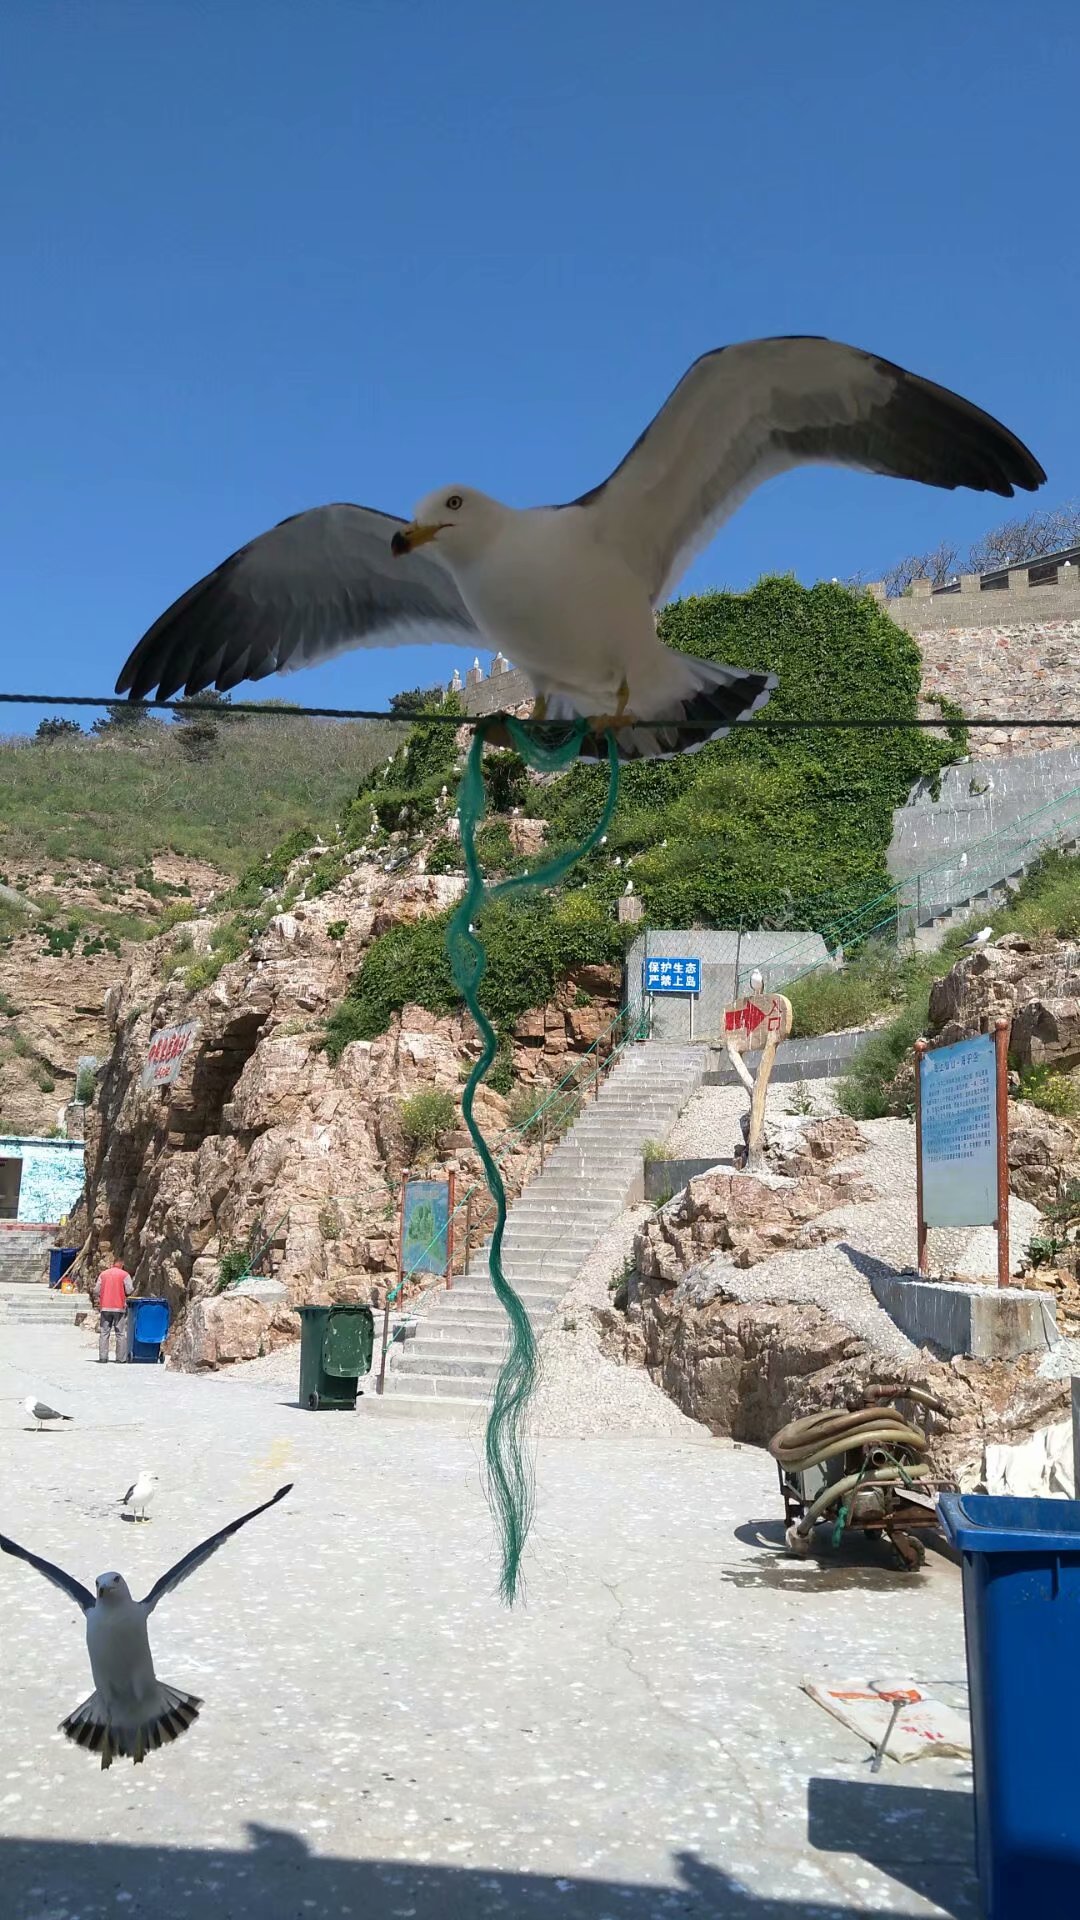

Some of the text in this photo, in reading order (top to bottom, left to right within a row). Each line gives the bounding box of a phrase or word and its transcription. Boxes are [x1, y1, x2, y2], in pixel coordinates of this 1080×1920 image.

[648, 961, 697, 974] 保护生态
[648, 975, 697, 987] 严禁上岛
